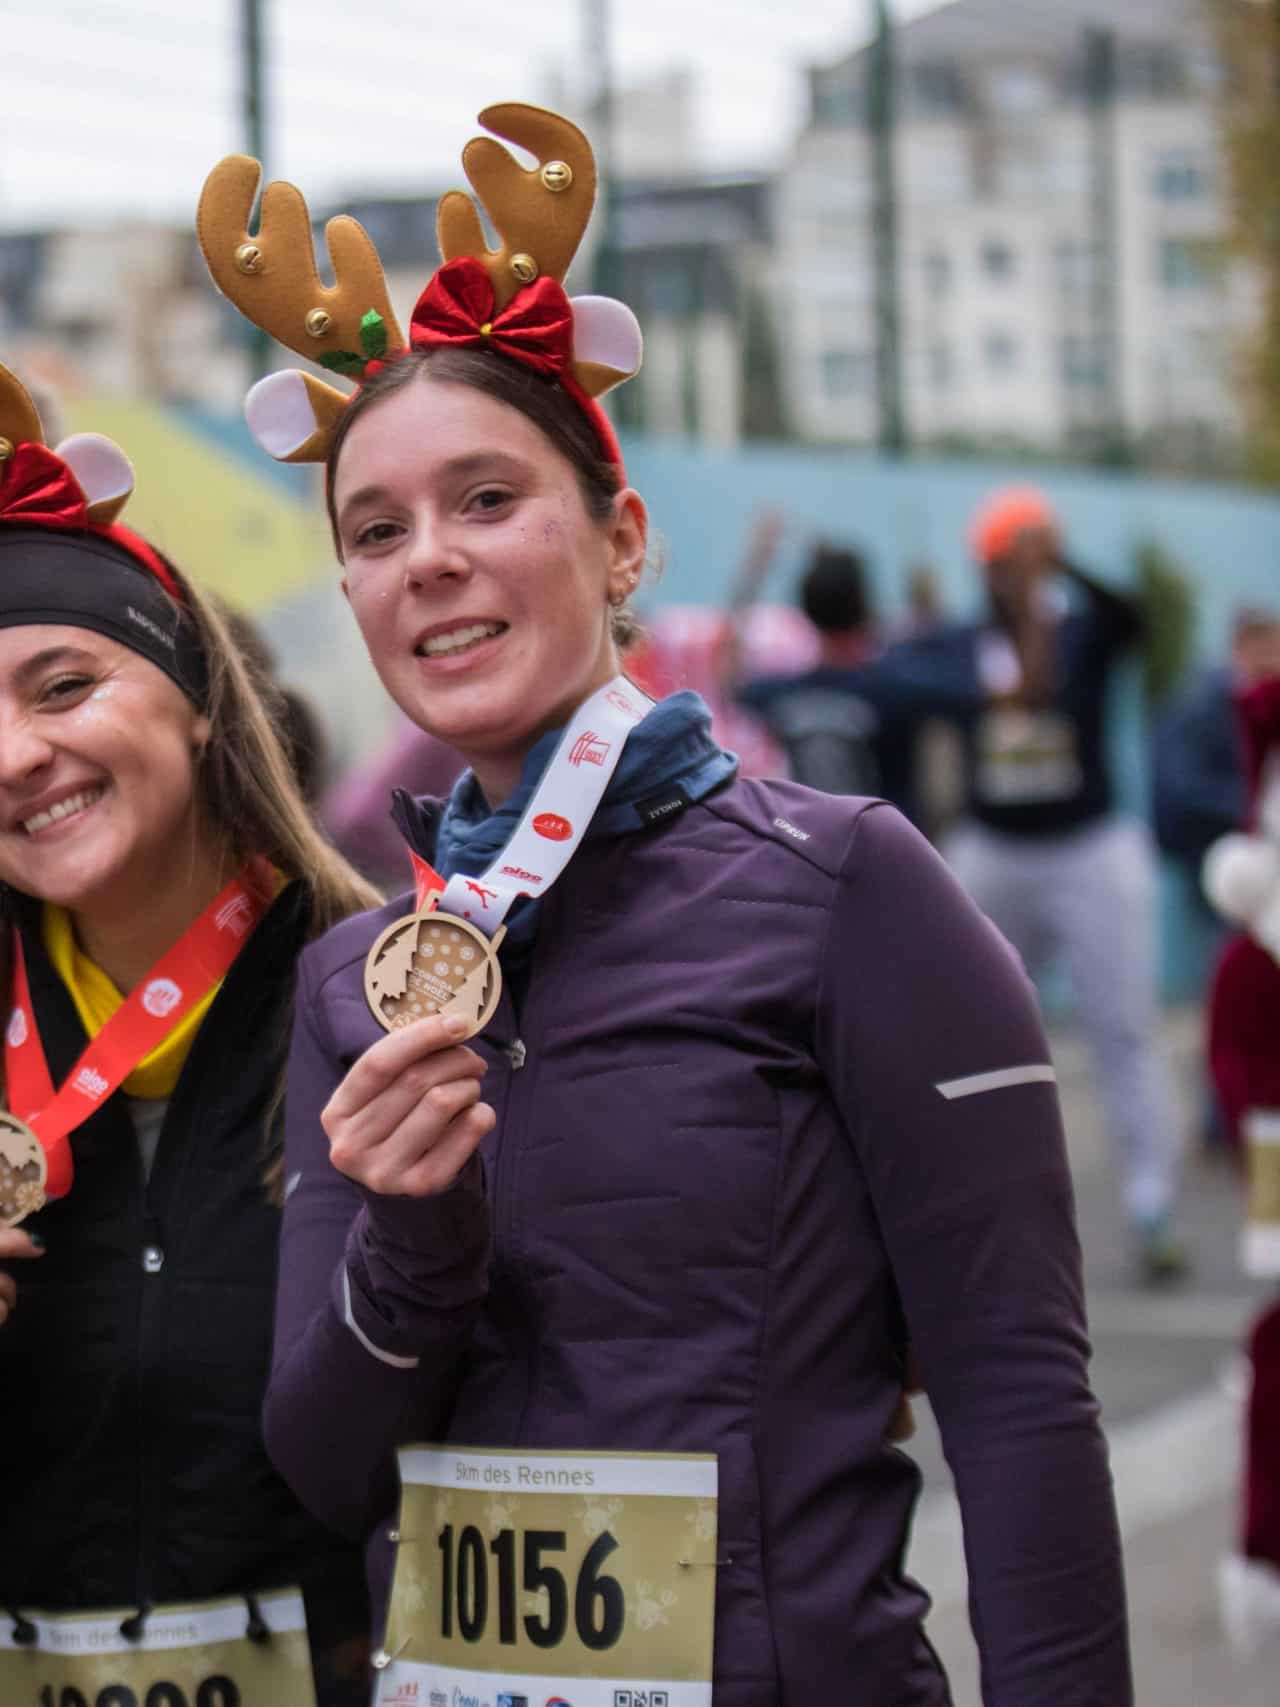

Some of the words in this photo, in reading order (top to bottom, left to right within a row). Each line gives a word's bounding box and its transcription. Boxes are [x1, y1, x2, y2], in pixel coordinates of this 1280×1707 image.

[455, 1460, 480, 1481] 5km
[484, 1463, 512, 1484] des
[518, 1465, 595, 1487] Rennes
[437, 1523, 625, 1651] 10156
